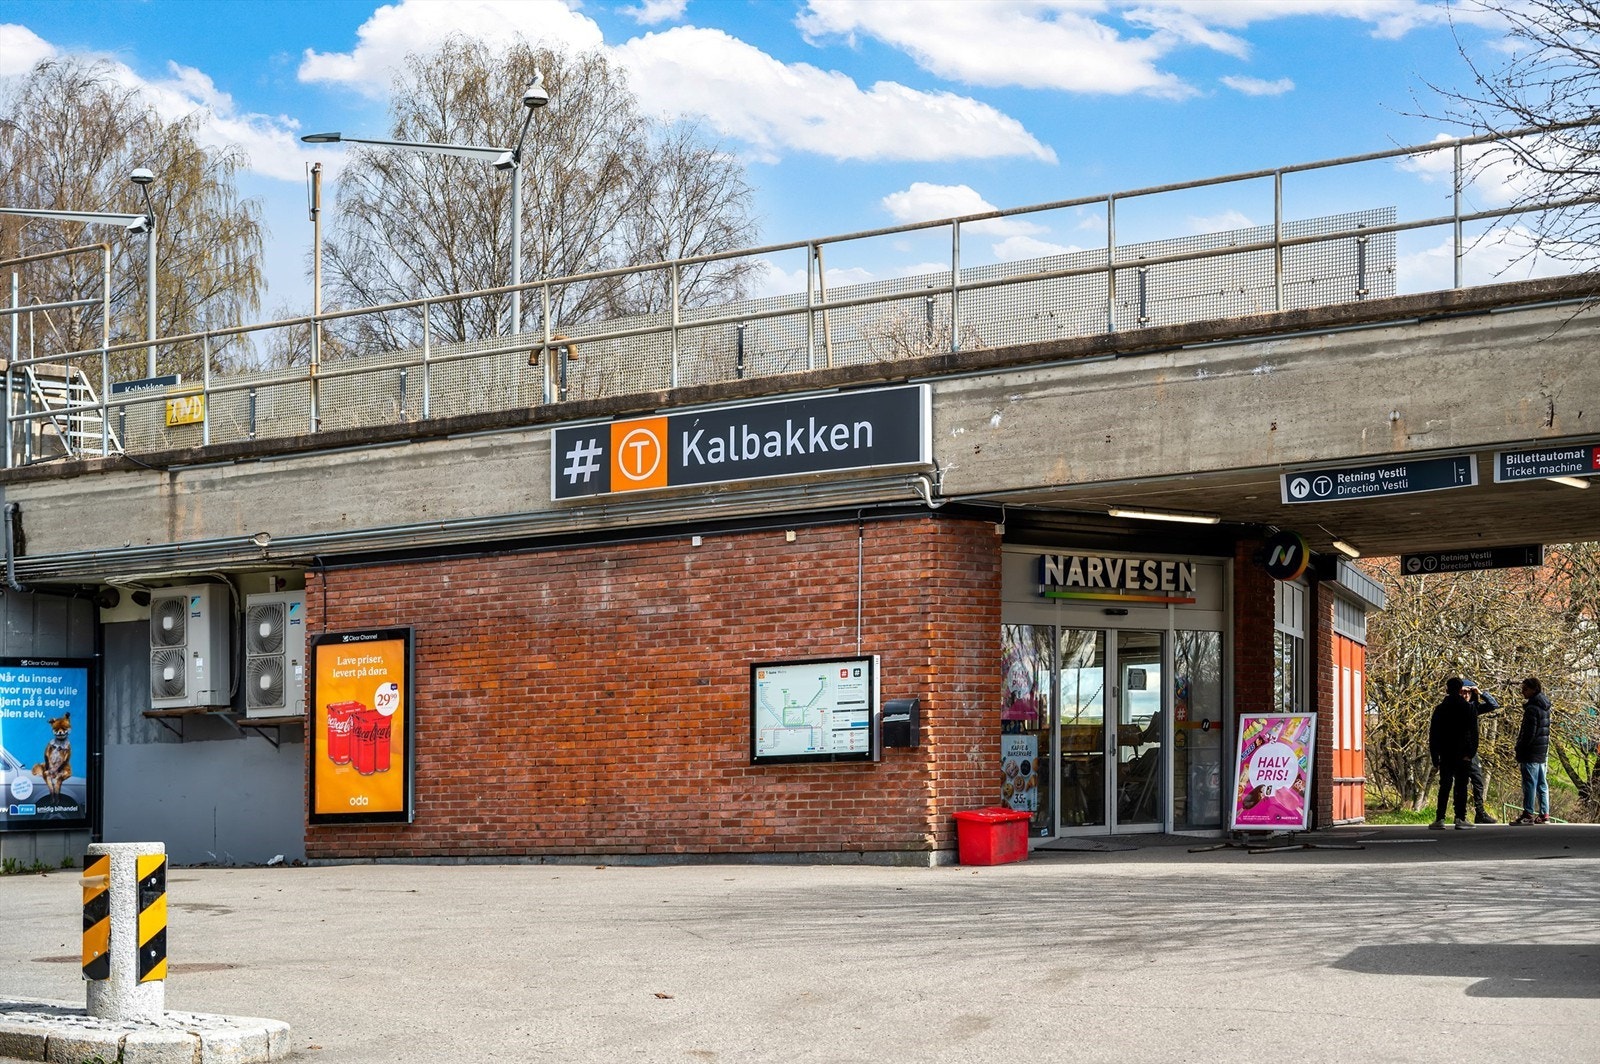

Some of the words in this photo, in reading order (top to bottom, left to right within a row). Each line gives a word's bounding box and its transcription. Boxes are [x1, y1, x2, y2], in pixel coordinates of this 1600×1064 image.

[682, 416, 873, 467] Kalbakken
[1506, 449, 1585, 465] Billettautomat
[1337, 471, 1376, 484] Retning
[1378, 466, 1407, 480] Vestli
[1506, 465, 1536, 477] Ticket
[1539, 462, 1583, 474] machine
[1459, 475, 1464, 483] 1
[1337, 483, 1380, 495] Direction
[1382, 479, 1409, 491] Vestli
[1440, 554, 1469, 562] Retning
[1470, 551, 1492, 560] Vestli
[1440, 562, 1472, 571] Direction
[1473, 560, 1493, 568] Vestli
[1044, 554, 1196, 592] NARVESEN
[337, 656, 356, 666] Lave
[357, 655, 384, 667] priser,
[0, 671, 16, 683] Når
[18, 673, 30, 683] du
[32, 673, 62, 683] innser
[333, 669, 356, 678] levert
[357, 668, 367, 679] på
[368, 666, 388, 676] døra
[22, 687, 42, 698] mye
[44, 686, 56, 695] du
[58, 686, 78, 695] ville
[23, 695, 35, 708] på
[37, 695, 43, 707] å
[44, 698, 70, 709] selge
[23, 709, 45, 718] selv.
[1257, 756, 1291, 768] HALV
[1256, 769, 1289, 781] PRIS!
[349, 795, 369, 806] oda
